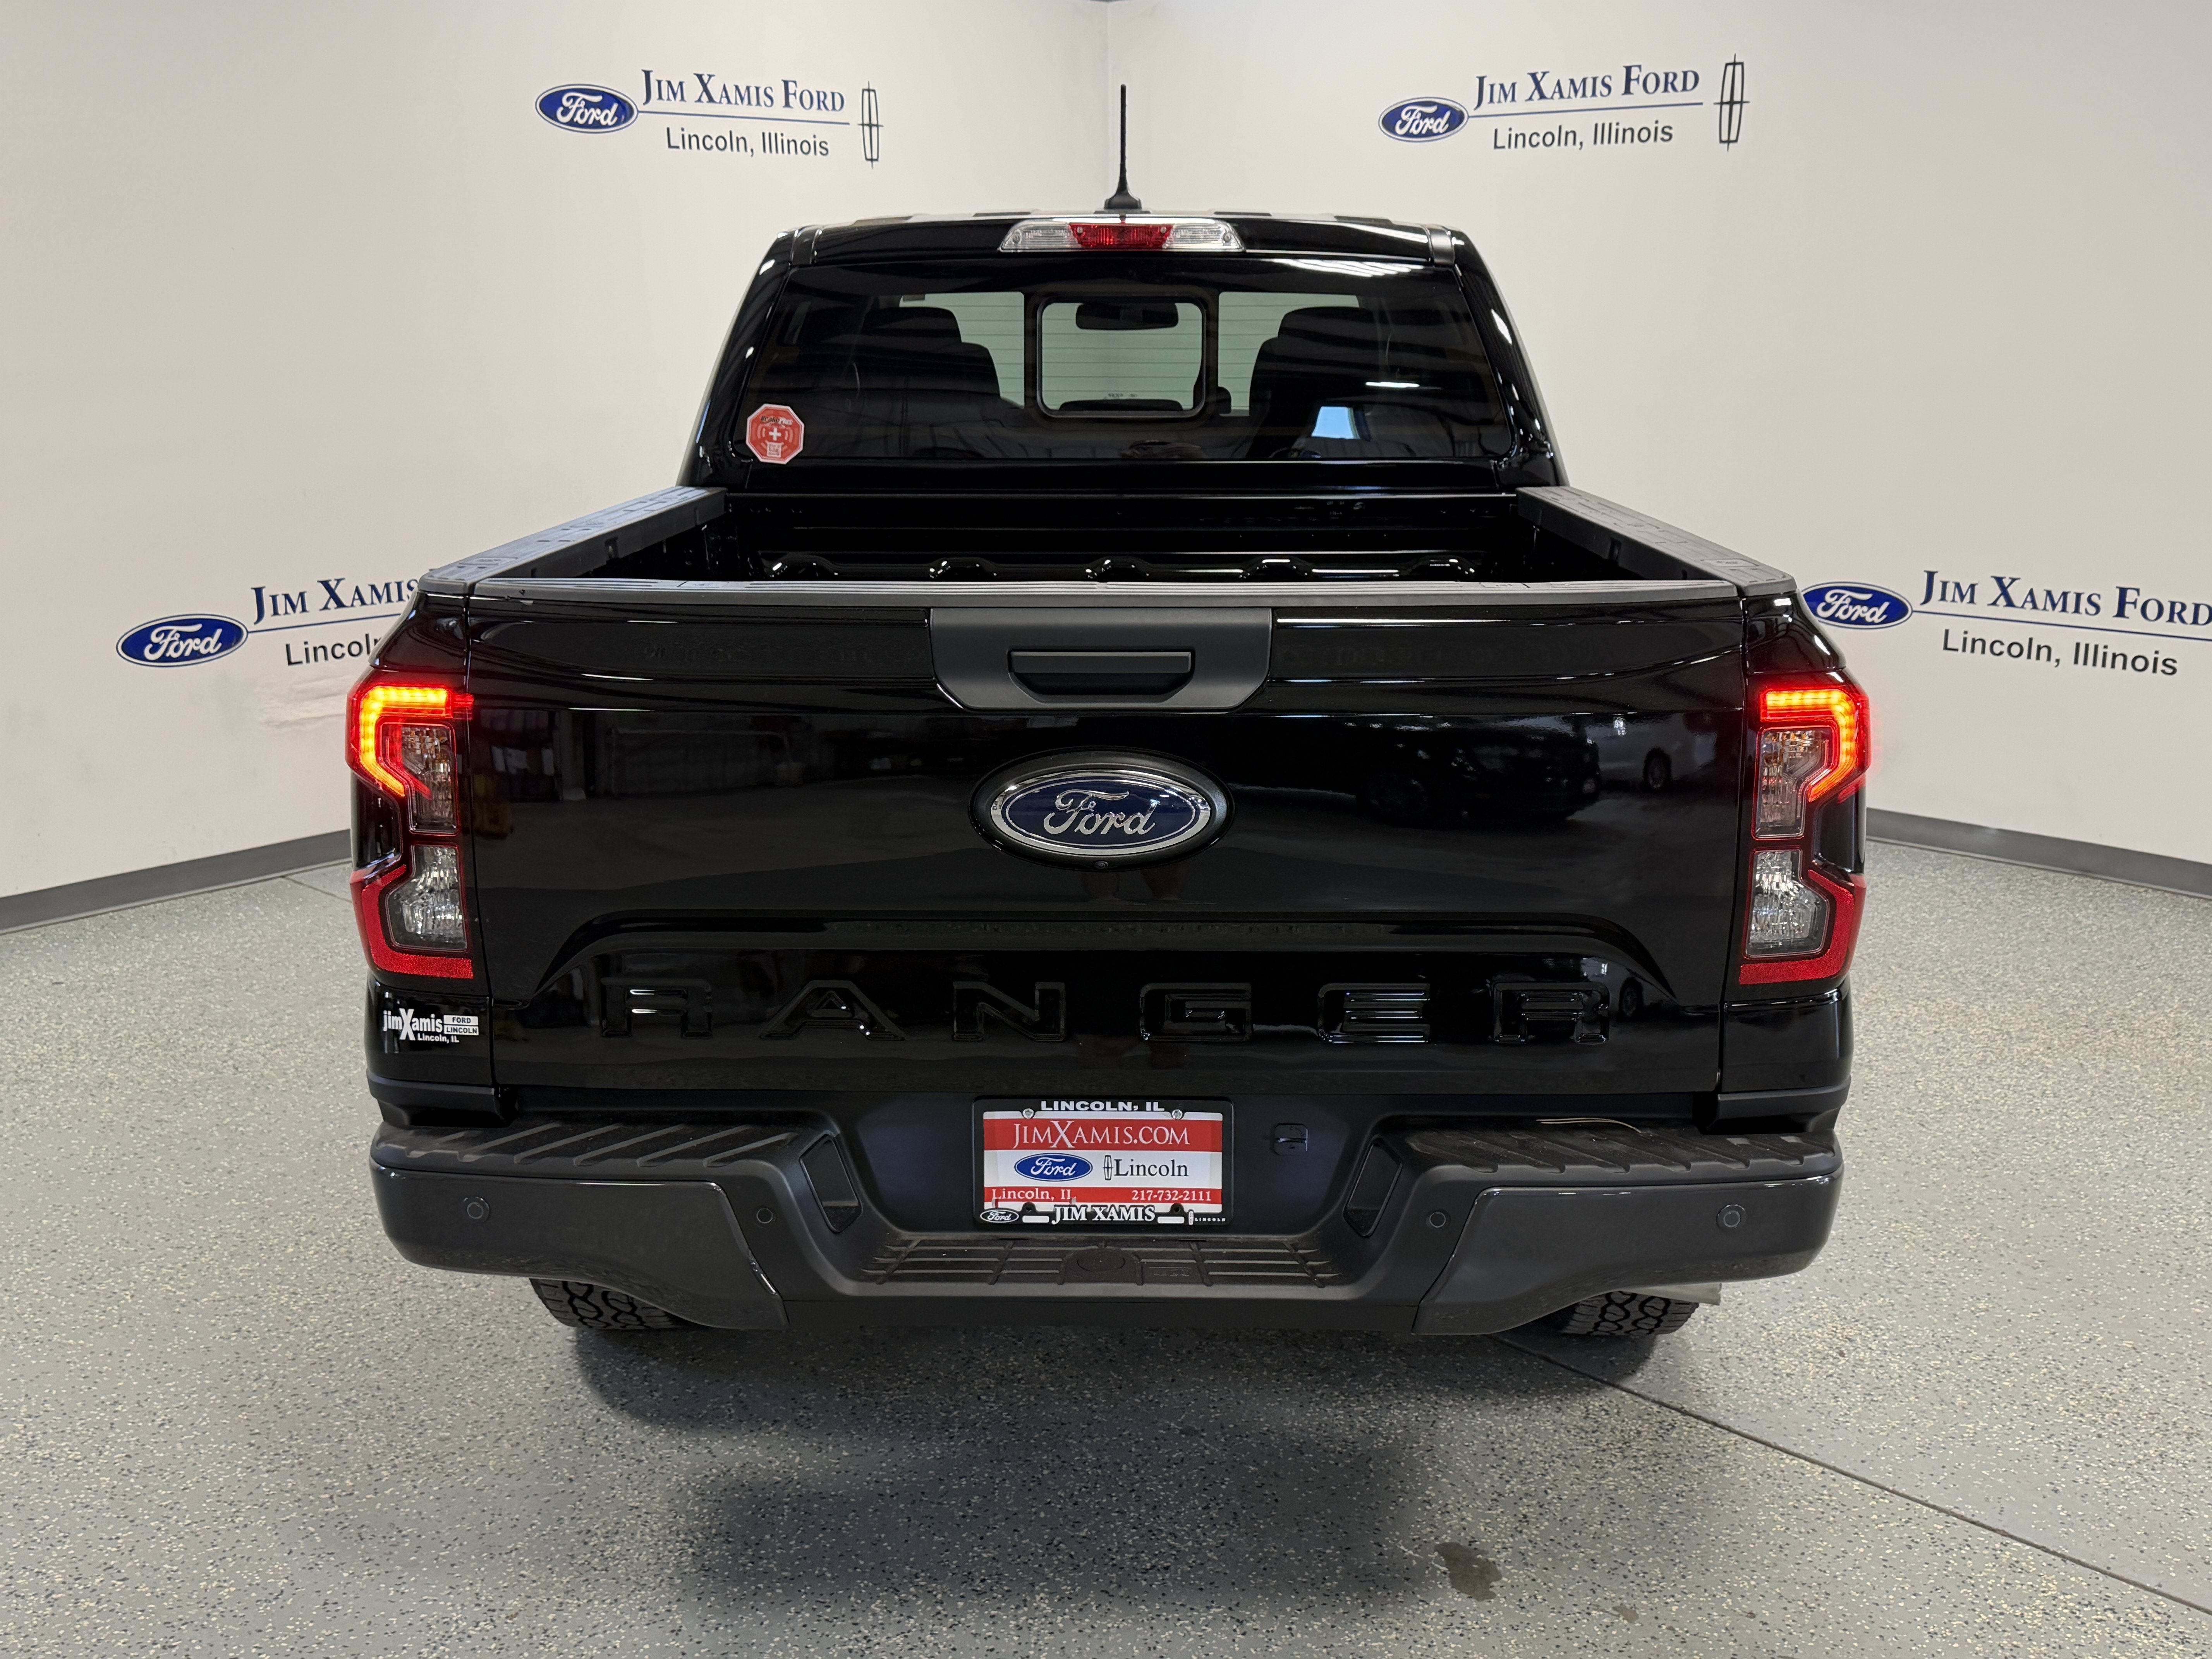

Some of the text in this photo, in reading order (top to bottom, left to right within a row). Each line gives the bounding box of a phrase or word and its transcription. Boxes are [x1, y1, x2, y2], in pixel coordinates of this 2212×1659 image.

[642, 70, 844, 111] JIM XAMIS FORD
[1474, 65, 1699, 110] JIM XAMIS FORD
[556, 92, 619, 127] Ford
[1395, 104, 1449, 135] Ford
[667, 127, 828, 157] Lincoln, Illinois
[1494, 120, 1673, 150] Lincoln, Illinois
[251, 586, 309, 625] JIM
[1817, 589, 1889, 624] Ford
[1920, 570, 1977, 605] JIM
[1987, 576, 2100, 616] XAMIS
[144, 624, 222, 660] Ford
[286, 633, 381, 666] Lincol
[1943, 629, 2177, 675] Lincoln, Illinois
[1044, 789, 1159, 835] Ford
[599, 977, 1612, 1045] RANGER
[417, 1033, 449, 1043] Lincoln,
[1041, 1101, 1165, 1111] LINCOLN, IL
[1030, 1158, 1076, 1176] Ford
[1114, 1159, 1188, 1176] Lincoln
[992, 1188, 1072, 1201] Lincoln, IL
[1132, 1190, 1211, 1201] 217-732-2111
[988, 1211, 1012, 1220] Ford
[1052, 1206, 1155, 1224] JIM XAMIS
